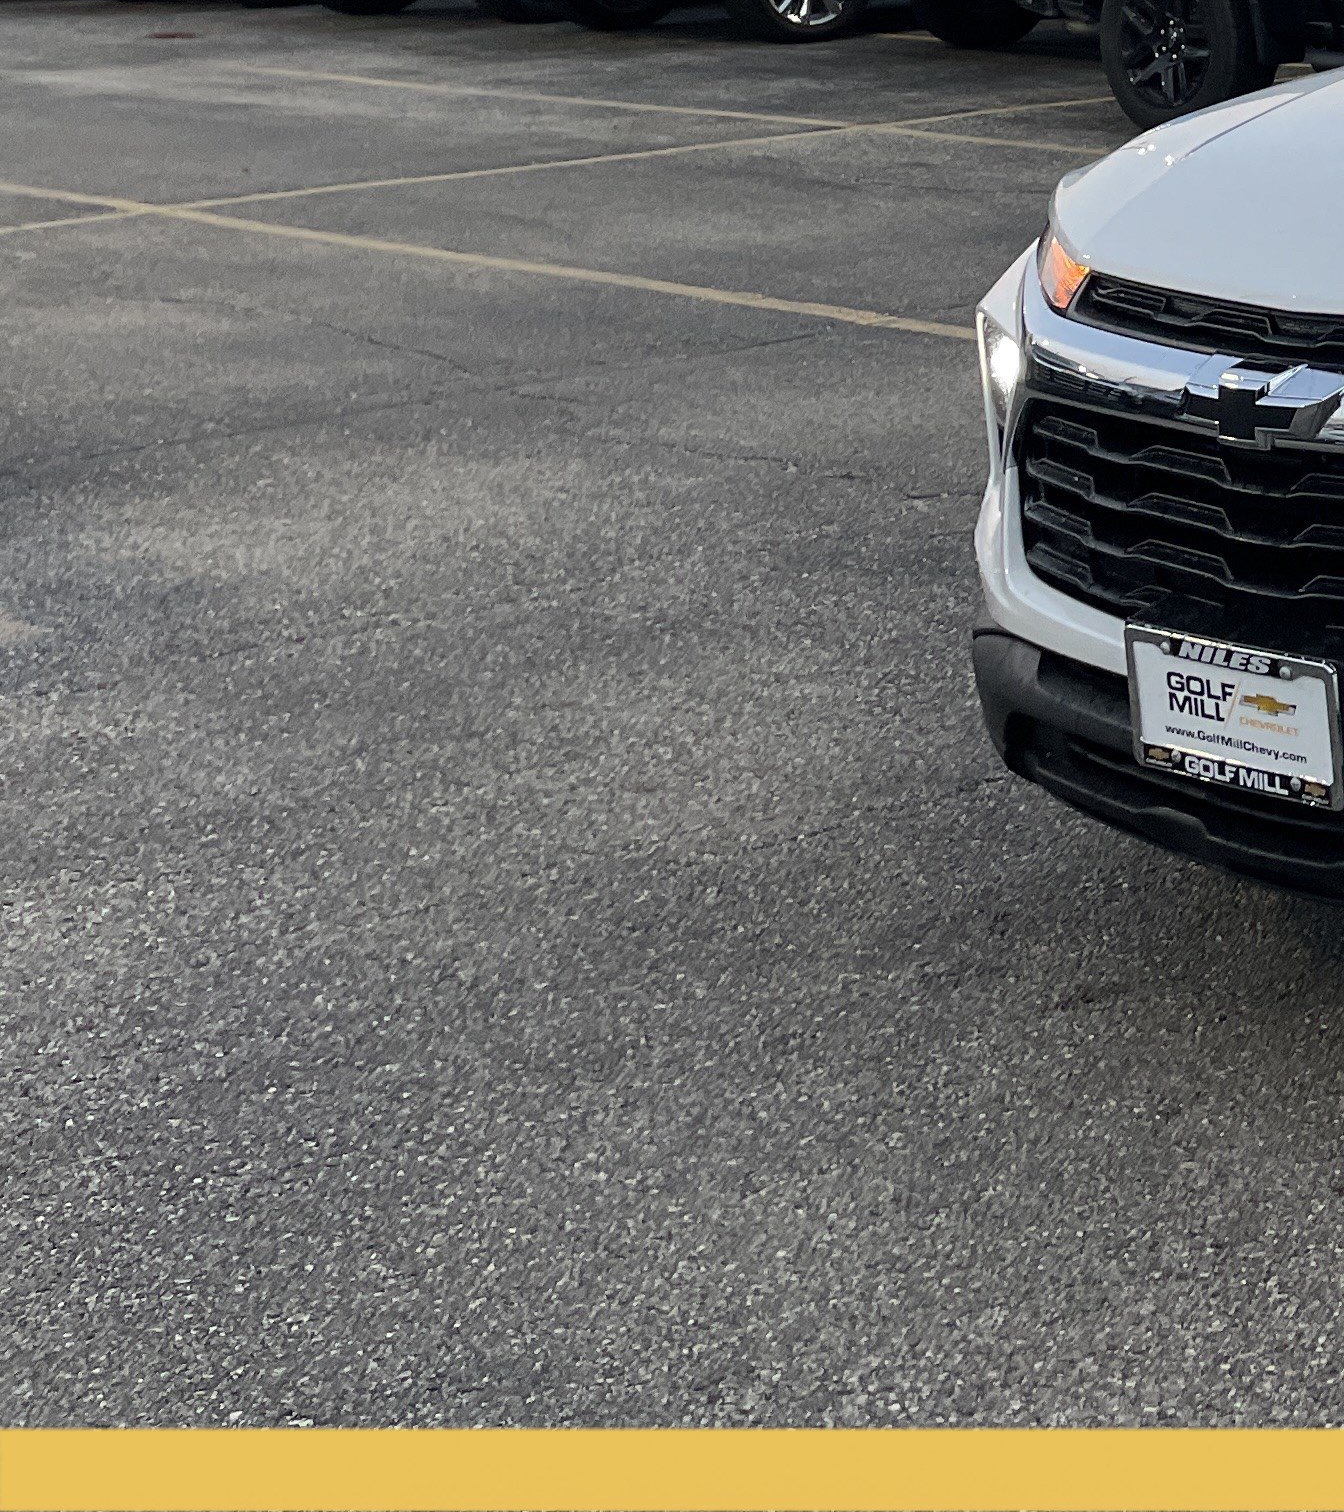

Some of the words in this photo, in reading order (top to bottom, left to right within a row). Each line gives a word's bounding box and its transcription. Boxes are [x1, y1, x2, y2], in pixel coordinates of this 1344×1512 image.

[1179, 640, 1272, 674] NILES
[1166, 671, 1236, 702] GOLF
[1168, 691, 1226, 722] MILL
[1239, 716, 1300, 737] CHEVROLET
[1165, 725, 1308, 764] www.GolfMillChevy.com
[1184, 755, 1237, 783] GOLF
[1238, 767, 1290, 796] MILL
